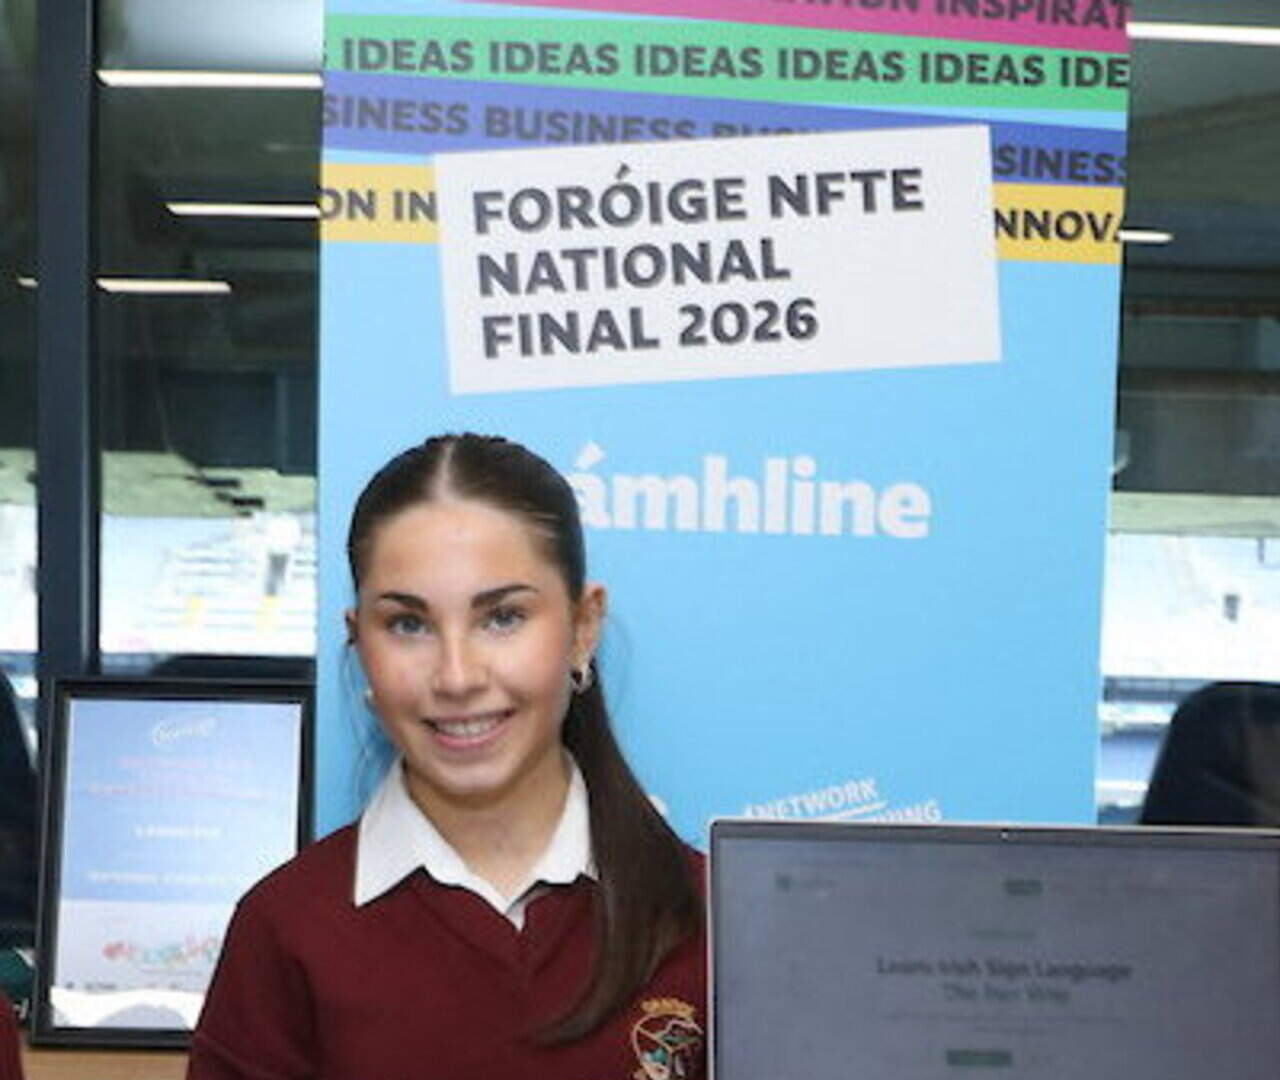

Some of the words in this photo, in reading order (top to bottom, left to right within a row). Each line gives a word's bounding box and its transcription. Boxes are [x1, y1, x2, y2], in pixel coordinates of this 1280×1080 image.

[342, 37, 474, 73] IDEAS
[489, 40, 620, 76] IDEAS
[633, 43, 763, 79] IDEAS
[777, 47, 907, 83] IDEAS
[919, 51, 1046, 87] IDEAS
[1060, 56, 1128, 89] IDE
[991, 143, 1127, 183] SINES
[472, 163, 747, 236] FORÓIGE
[768, 167, 926, 220] NFTE
[993, 206, 1120, 243] NNOV
[476, 237, 792, 297] NATIONAL
[482, 305, 661, 359] FINAL
[677, 297, 820, 347] 2026
